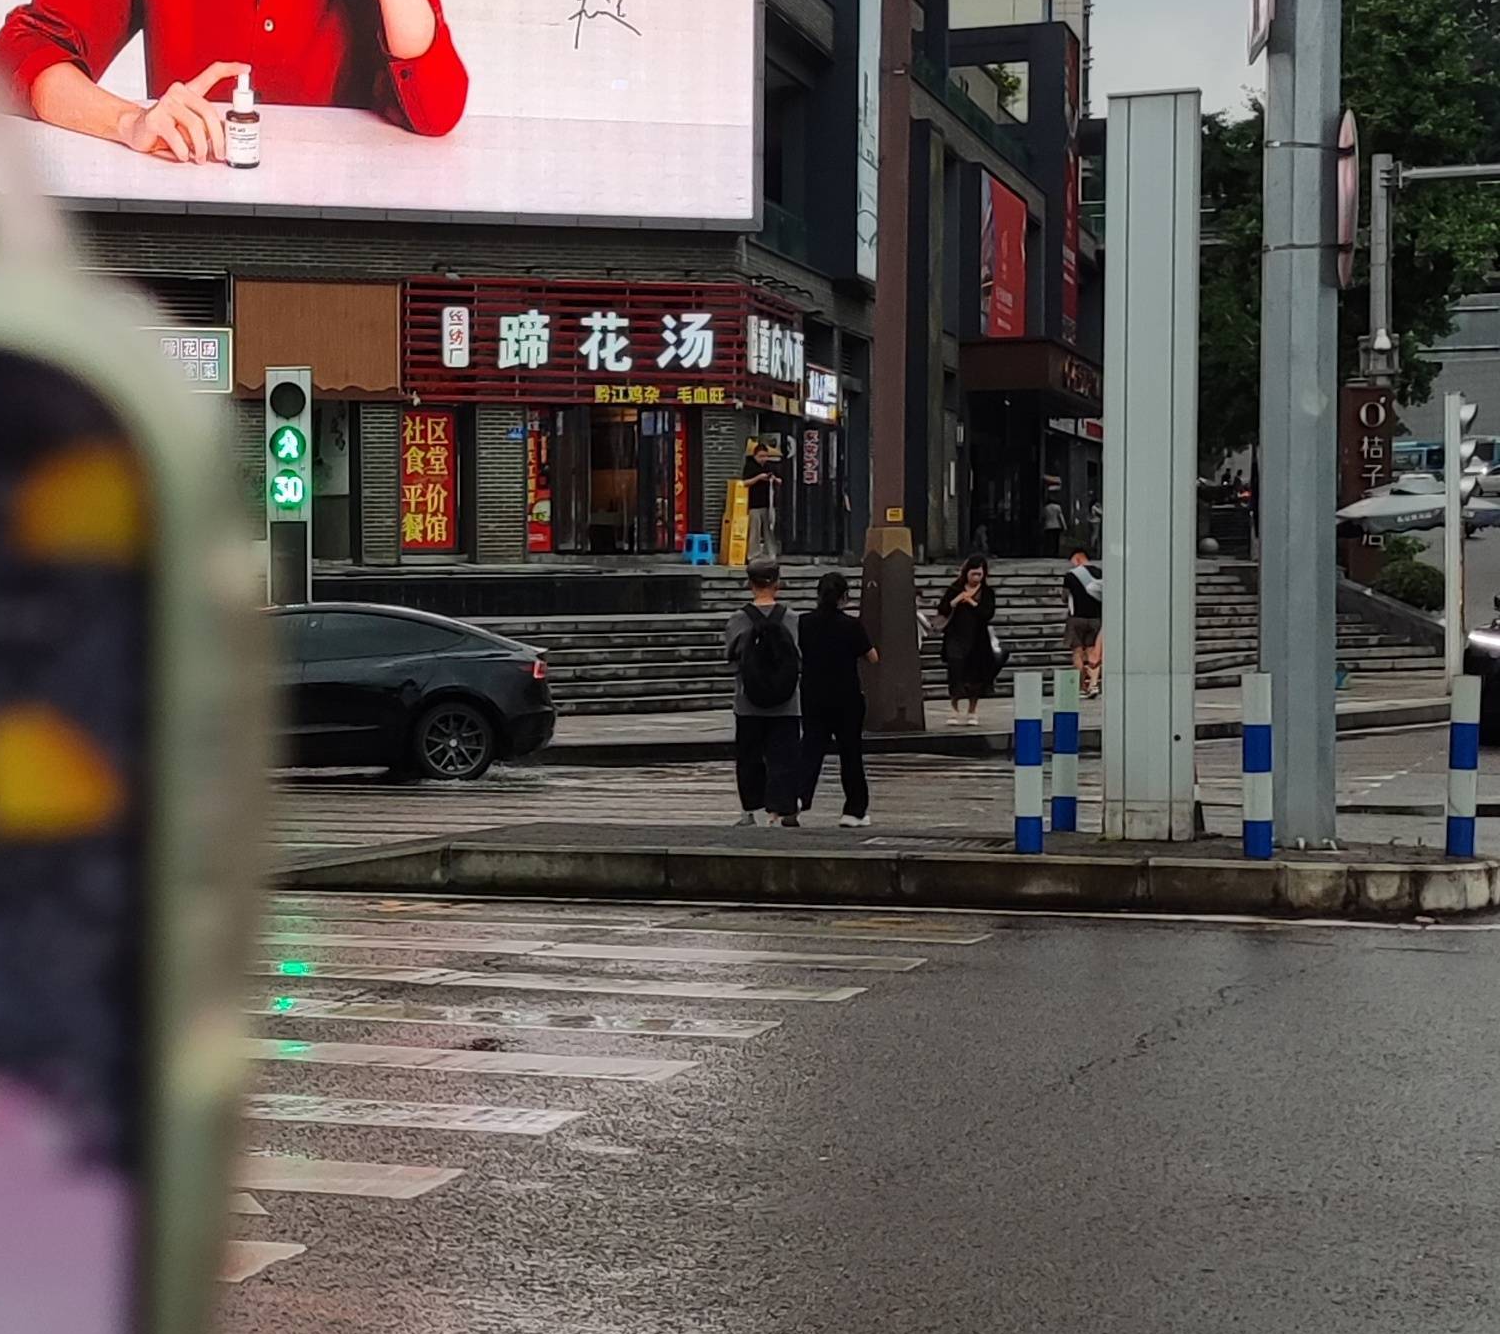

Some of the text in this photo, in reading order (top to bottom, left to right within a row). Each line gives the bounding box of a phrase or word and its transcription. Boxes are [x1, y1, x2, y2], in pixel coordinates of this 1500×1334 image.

[498, 309, 715, 372] 蹄花汤
[594, 385, 726, 405] 黔江鸡杂 毛血旺
[402, 416, 449, 445] 社区
[402, 447, 449, 476] 食堂
[274, 476, 303, 503] 30
[402, 483, 448, 513] 平价
[402, 513, 449, 544] 餐馆
